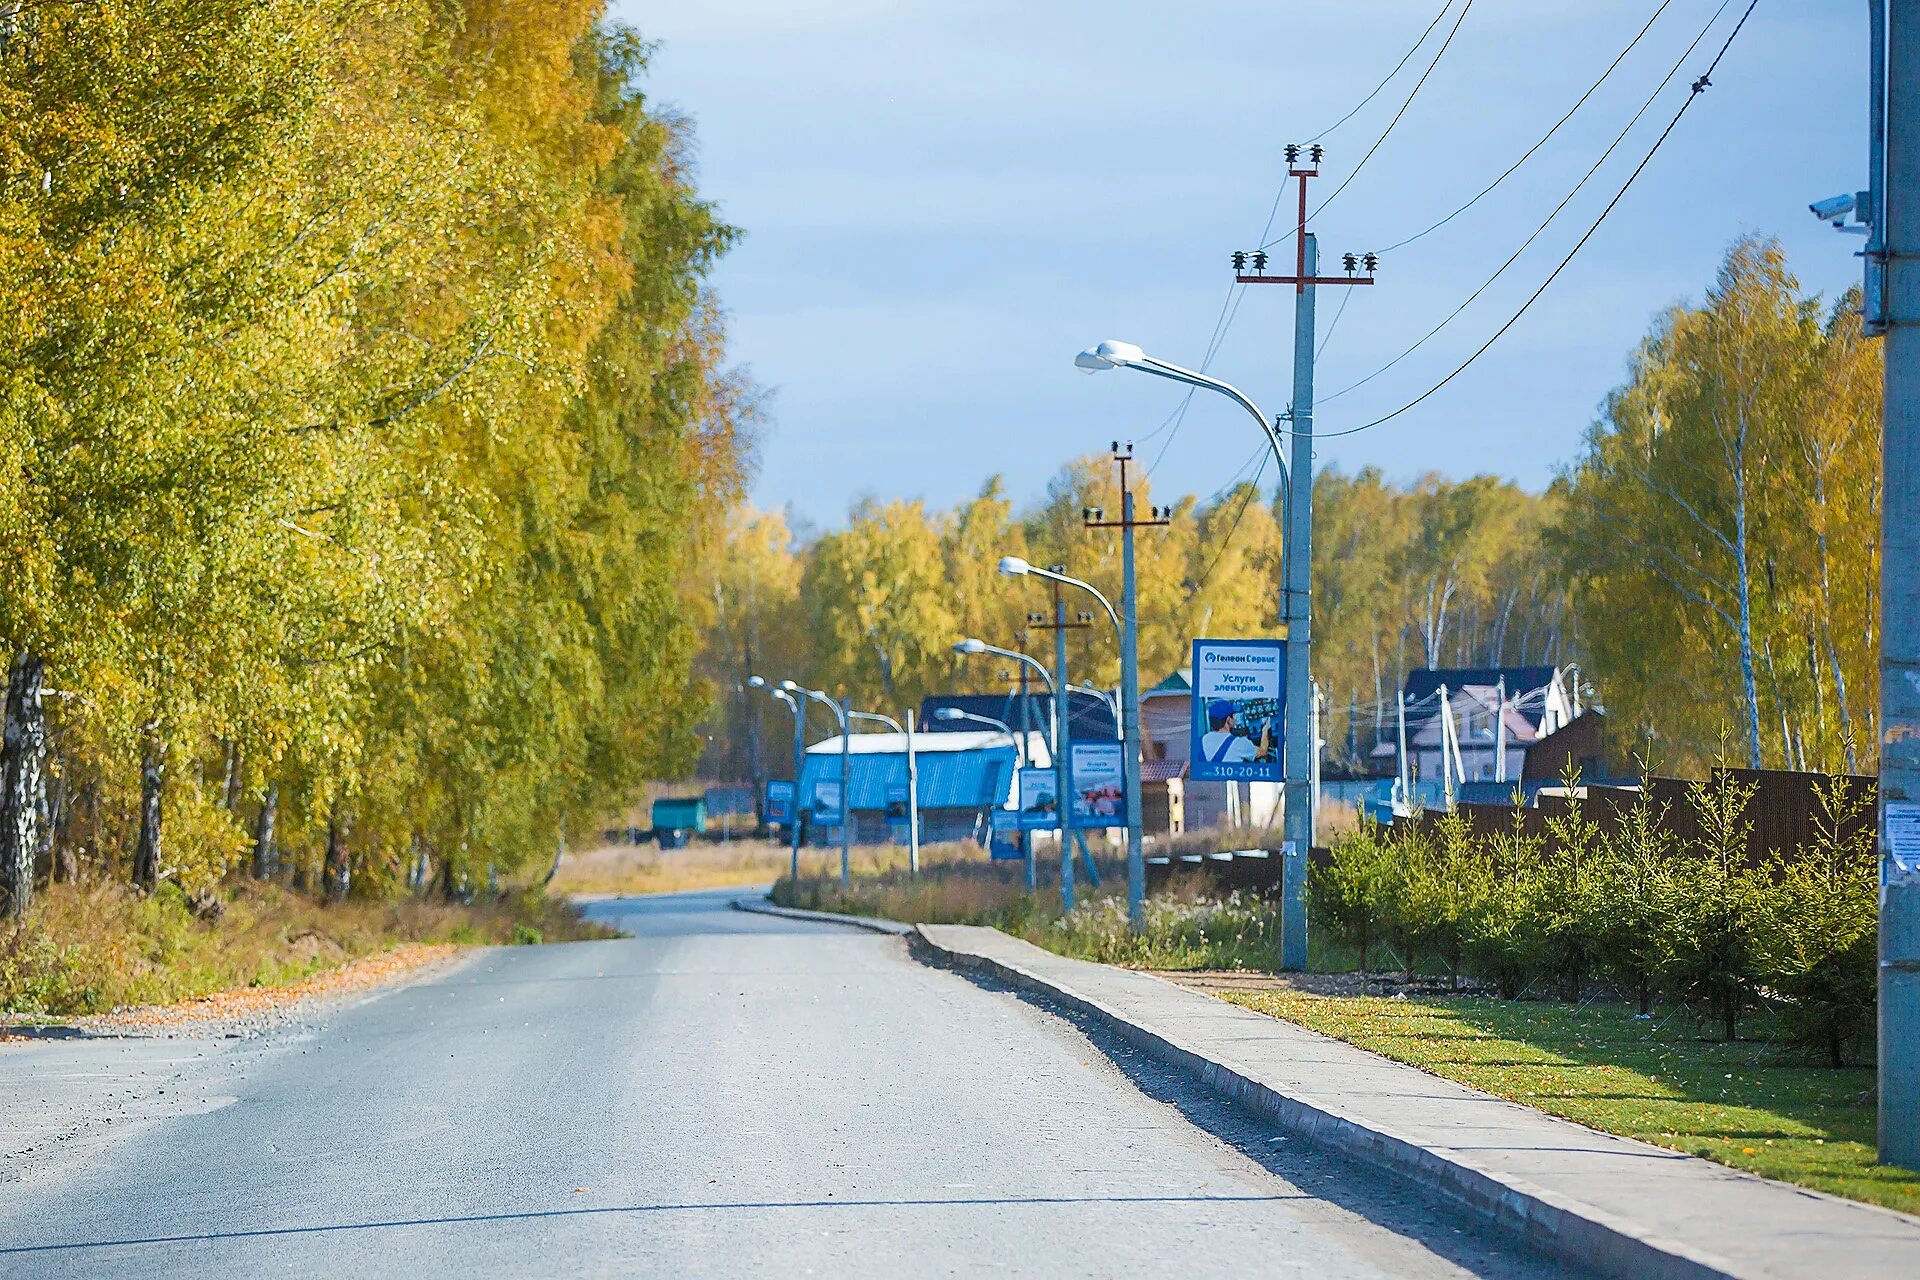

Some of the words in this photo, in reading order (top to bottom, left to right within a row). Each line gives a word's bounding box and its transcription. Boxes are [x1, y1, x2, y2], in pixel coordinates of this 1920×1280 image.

[1222, 674, 1256, 684] Услуги
[1214, 685, 1264, 693] электрика
[1214, 766, 1271, 777] 310-20-11
